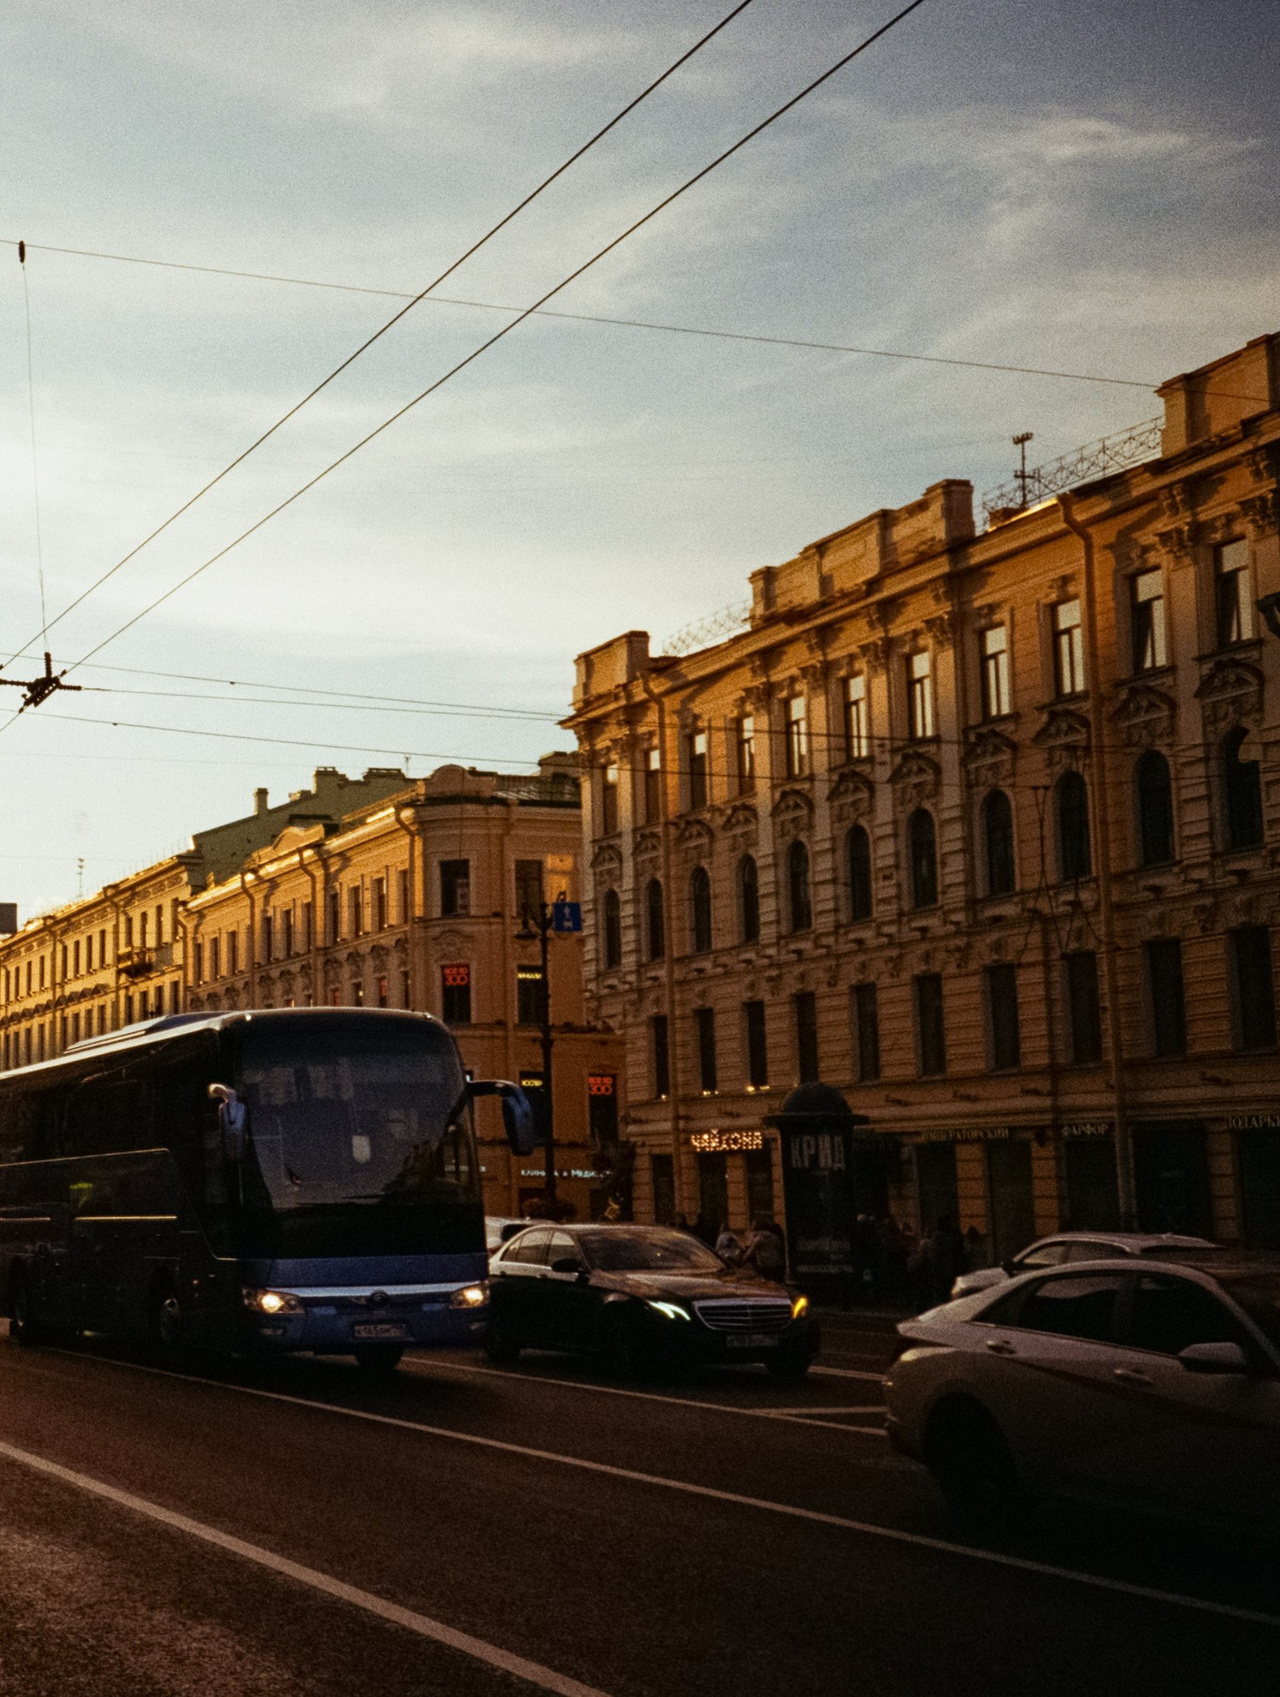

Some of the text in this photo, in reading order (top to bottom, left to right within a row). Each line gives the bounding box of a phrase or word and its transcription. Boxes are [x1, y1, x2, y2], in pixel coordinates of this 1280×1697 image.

[444, 974, 469, 986] 300
[589, 1084, 613, 1096] 300
[690, 1128, 763, 1152] ЧАЙХОНА
